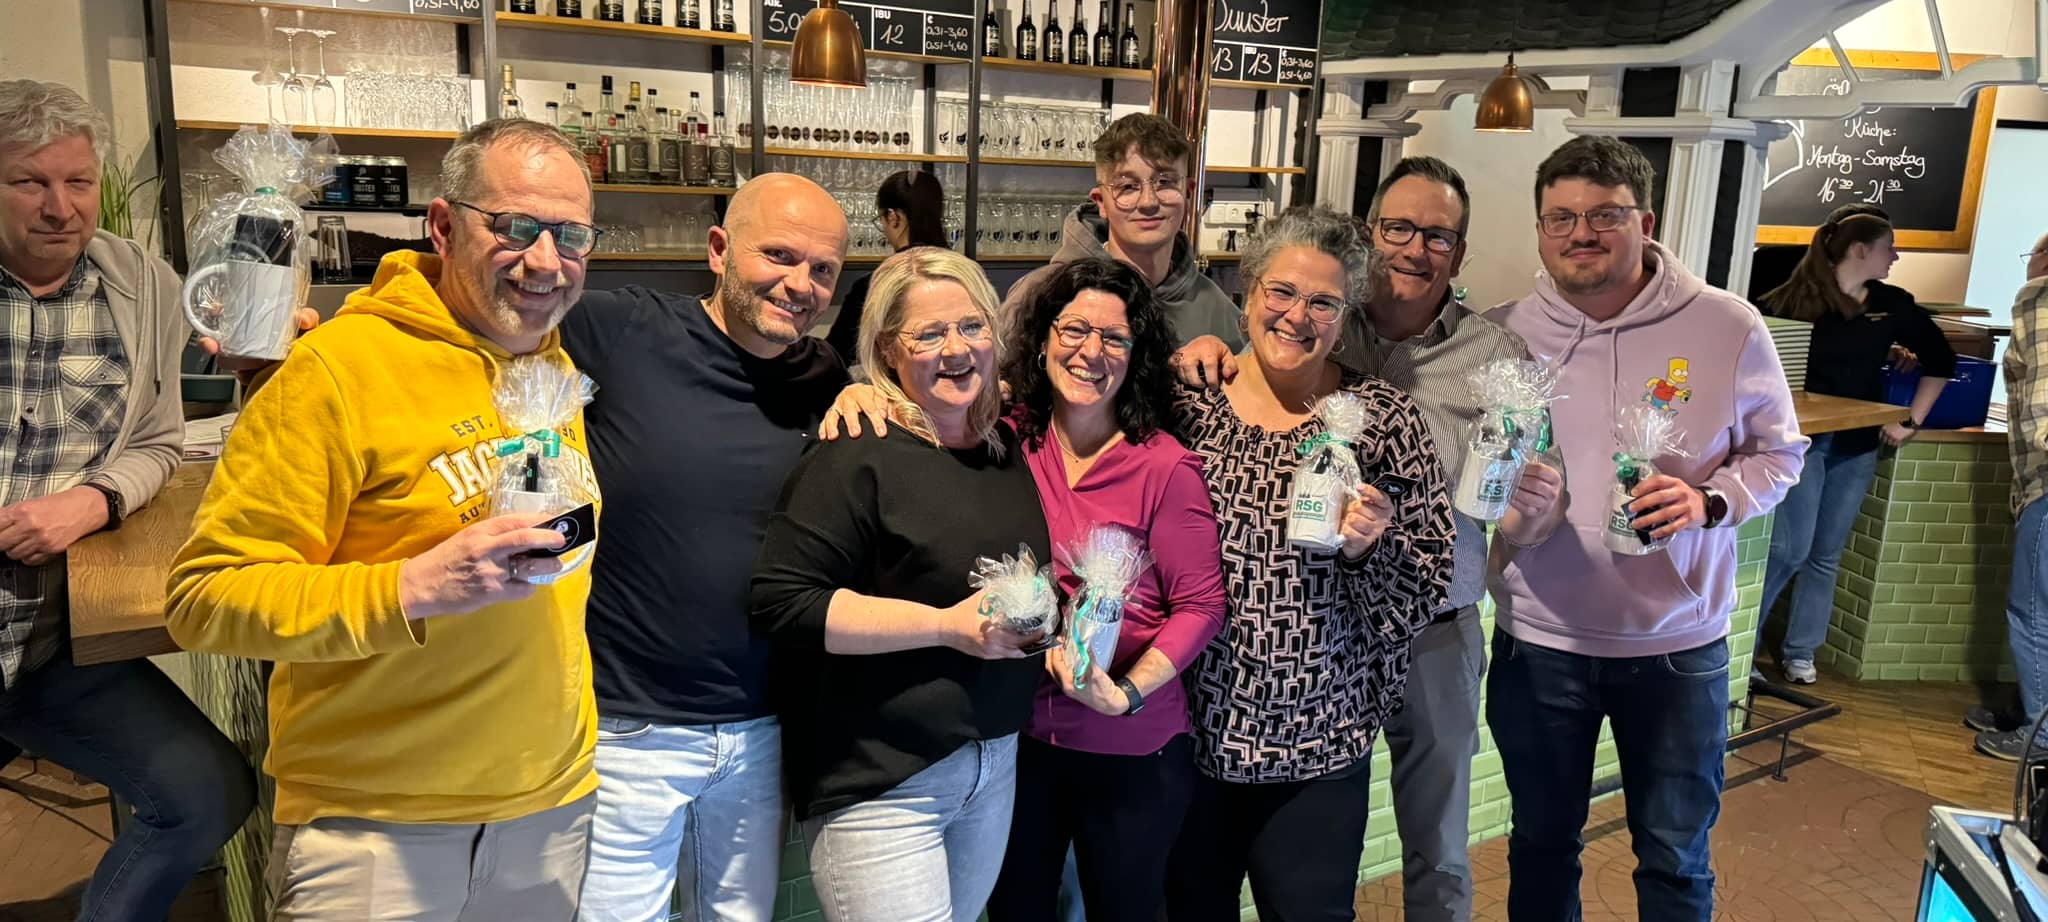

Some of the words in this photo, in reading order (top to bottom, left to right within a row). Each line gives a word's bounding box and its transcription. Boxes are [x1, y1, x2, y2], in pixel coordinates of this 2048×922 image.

[875, 9, 891, 19] IBU
[880, 24, 904, 44] 12
[1211, 48, 1233, 73] 13
[1248, 53, 1272, 76] 13
[450, 415, 493, 437] EST.
[427, 436, 511, 507] JAC
[1295, 499, 1323, 512] RSG
